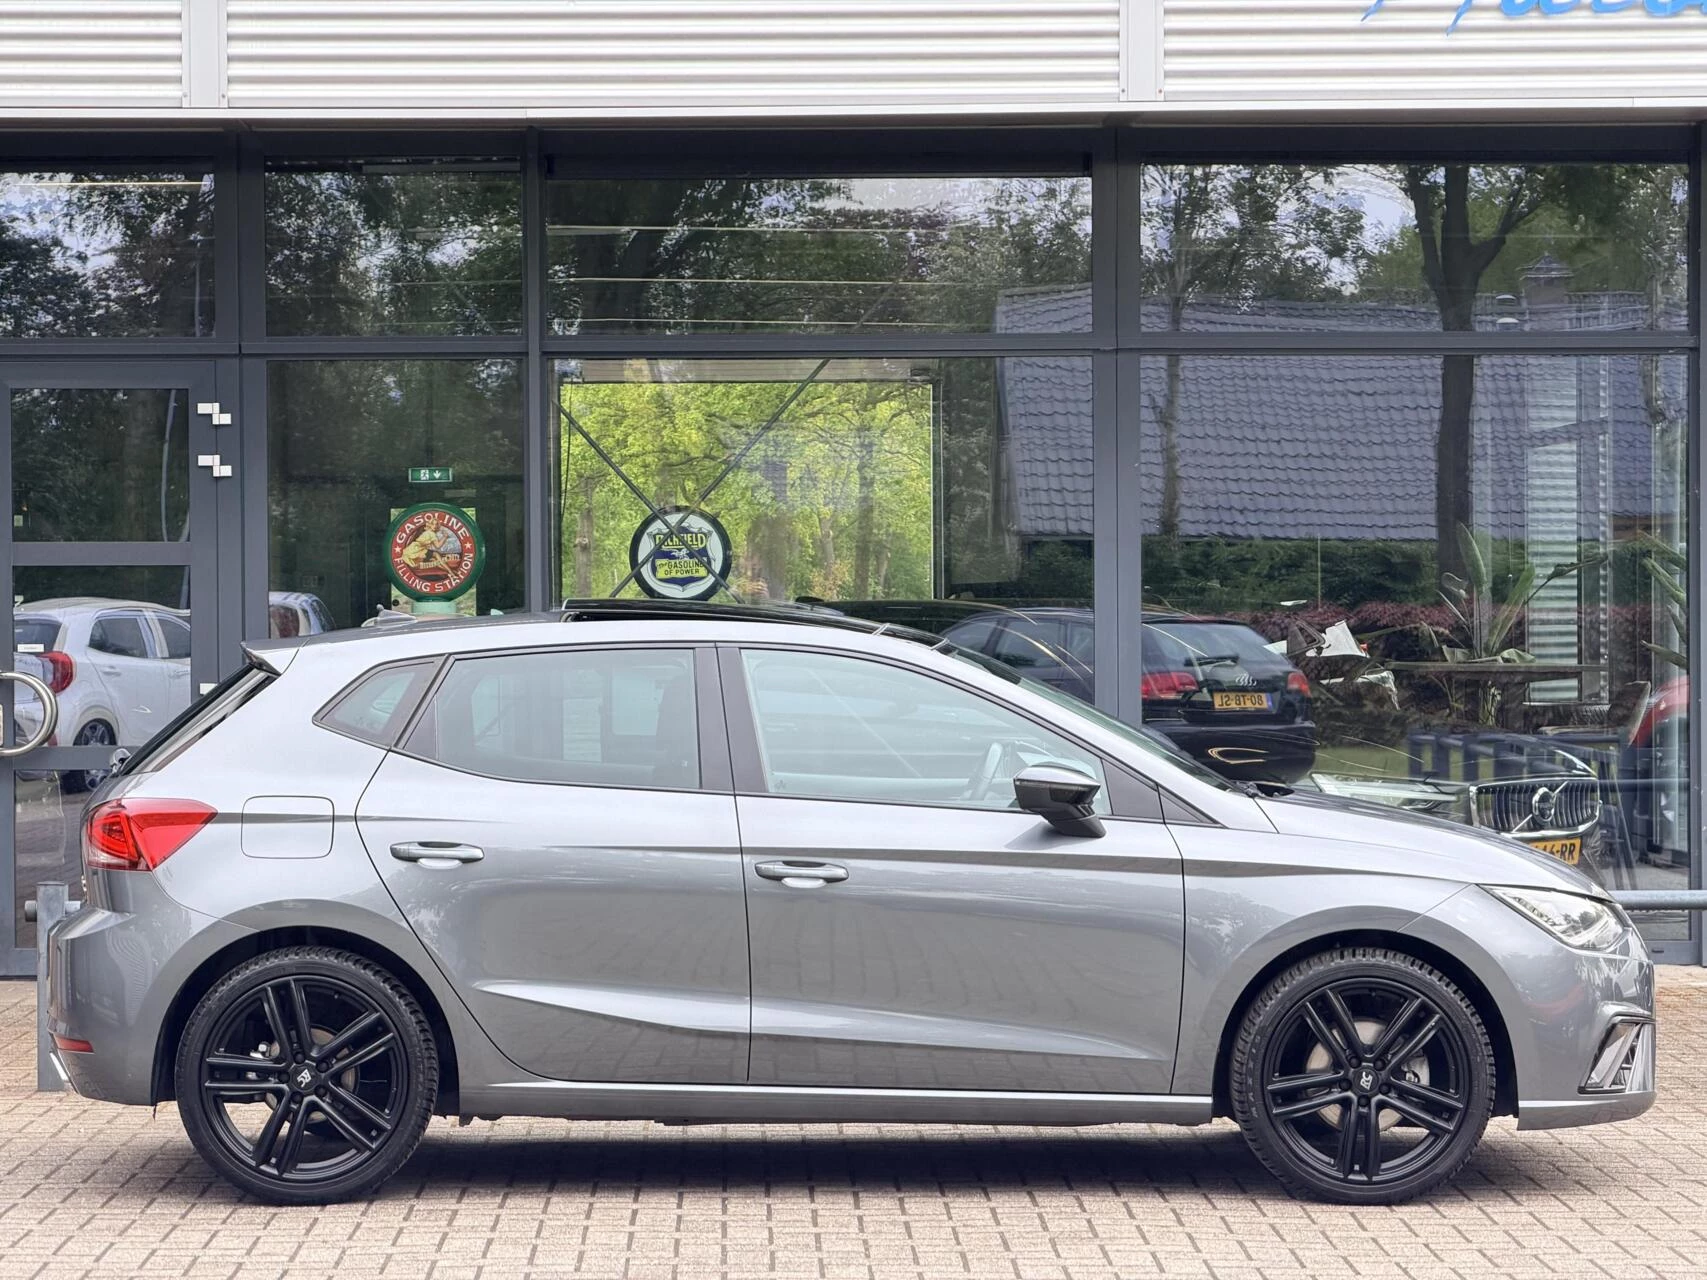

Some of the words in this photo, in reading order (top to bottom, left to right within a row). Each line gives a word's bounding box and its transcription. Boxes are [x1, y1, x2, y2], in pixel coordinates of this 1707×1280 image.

[396, 512, 469, 544] GASOLINE
[394, 557, 431, 592] FILLING
[434, 552, 474, 592] STATION
[675, 568, 700, 576] POWER
